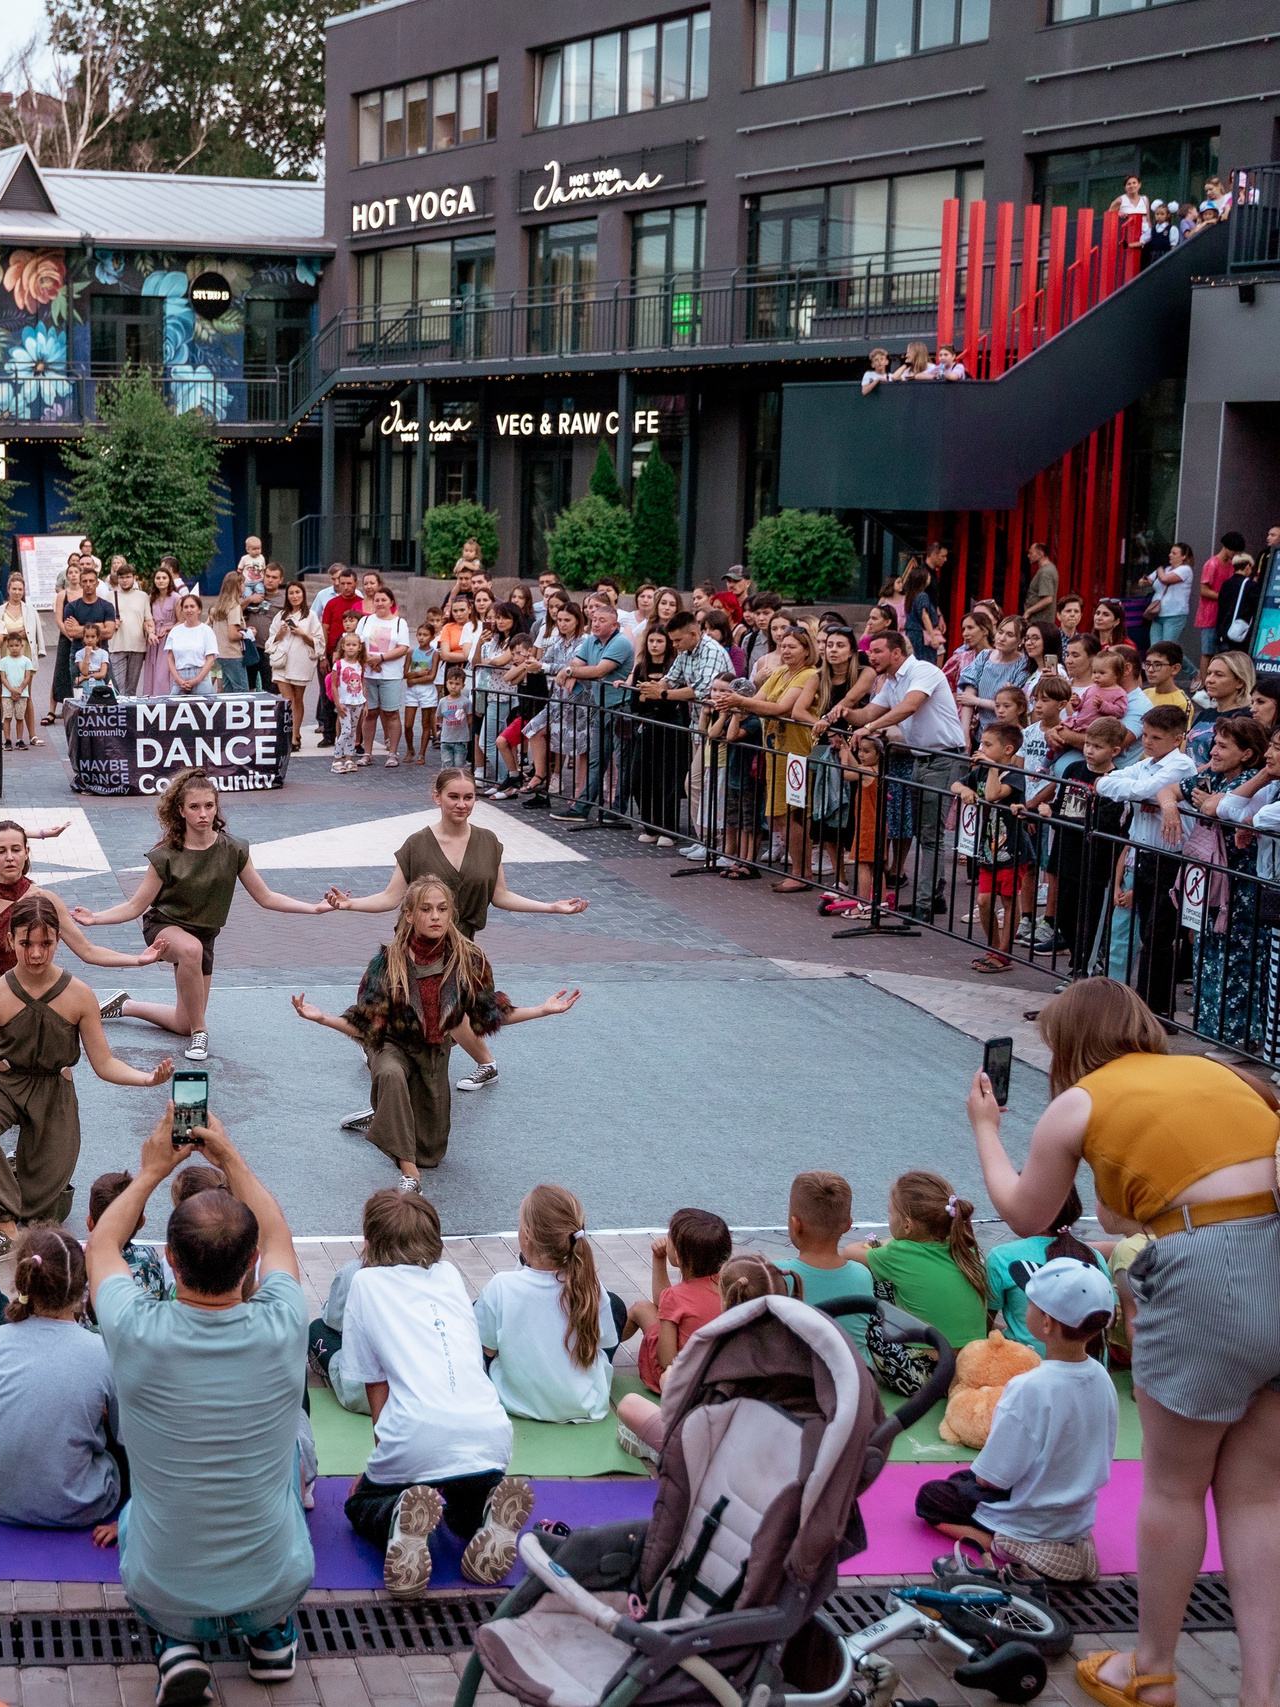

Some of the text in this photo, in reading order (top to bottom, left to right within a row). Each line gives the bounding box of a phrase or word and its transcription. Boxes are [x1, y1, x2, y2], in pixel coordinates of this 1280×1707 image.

[569, 167, 621, 187] HOT YOGA
[352, 185, 476, 232] HOT YOGA
[496, 410, 659, 435] VEG & RAW CFE
[77, 715, 127, 727] DANCE
[136, 700, 277, 732] MAYBE
[77, 728, 128, 737] Community
[136, 735, 277, 768] DANCE
[1027, 748, 1047, 757] WAR
[79, 759, 129, 771] MAYBE
[81, 772, 130, 784] DANCE
[440, 1331, 451, 1357] BLACK
[447, 1359, 457, 1393] SCHOOL
